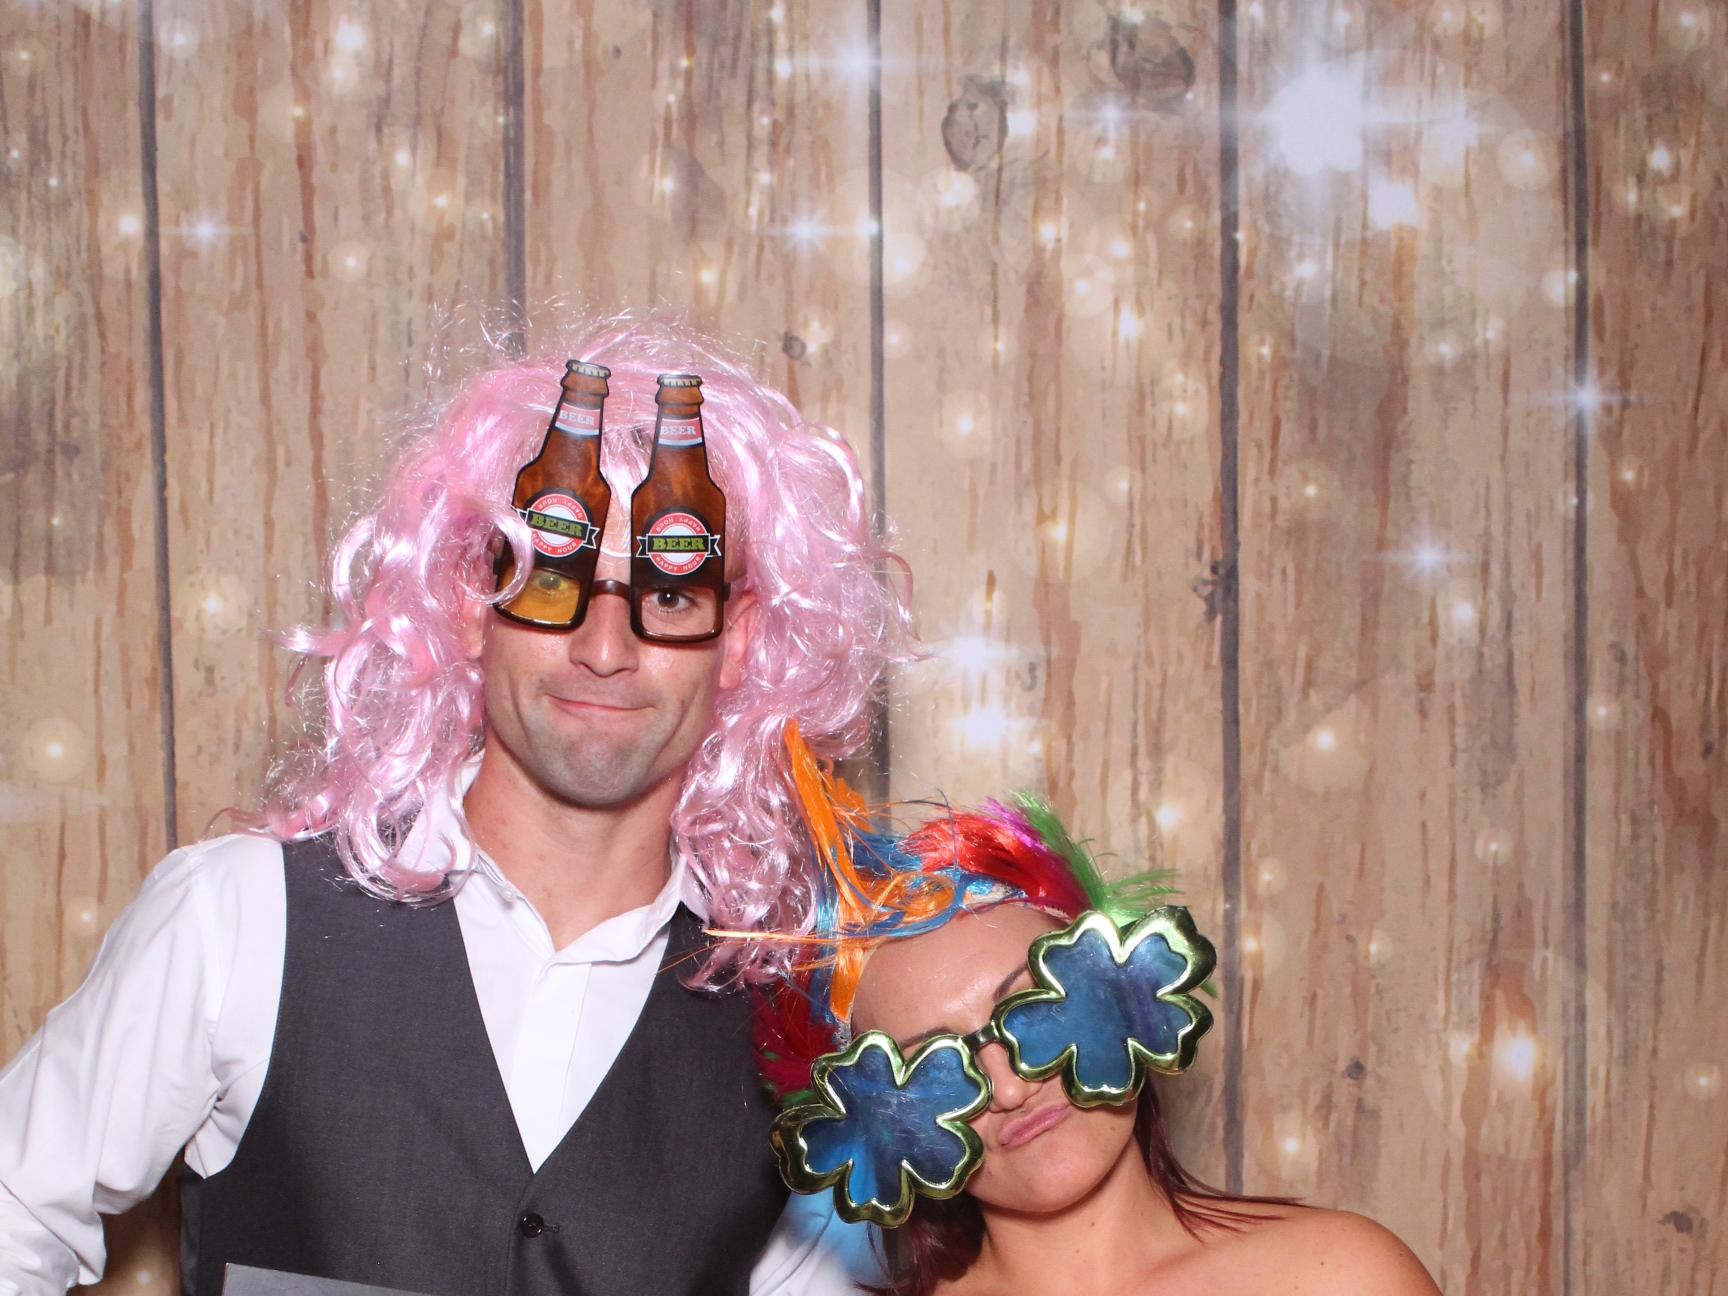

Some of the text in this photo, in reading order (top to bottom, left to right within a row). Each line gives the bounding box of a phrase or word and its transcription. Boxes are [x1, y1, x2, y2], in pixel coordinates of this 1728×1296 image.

[559, 410, 595, 426] BEER
[660, 425, 696, 435] BEER
[531, 513, 582, 537] BEER
[652, 537, 706, 551] BEER
